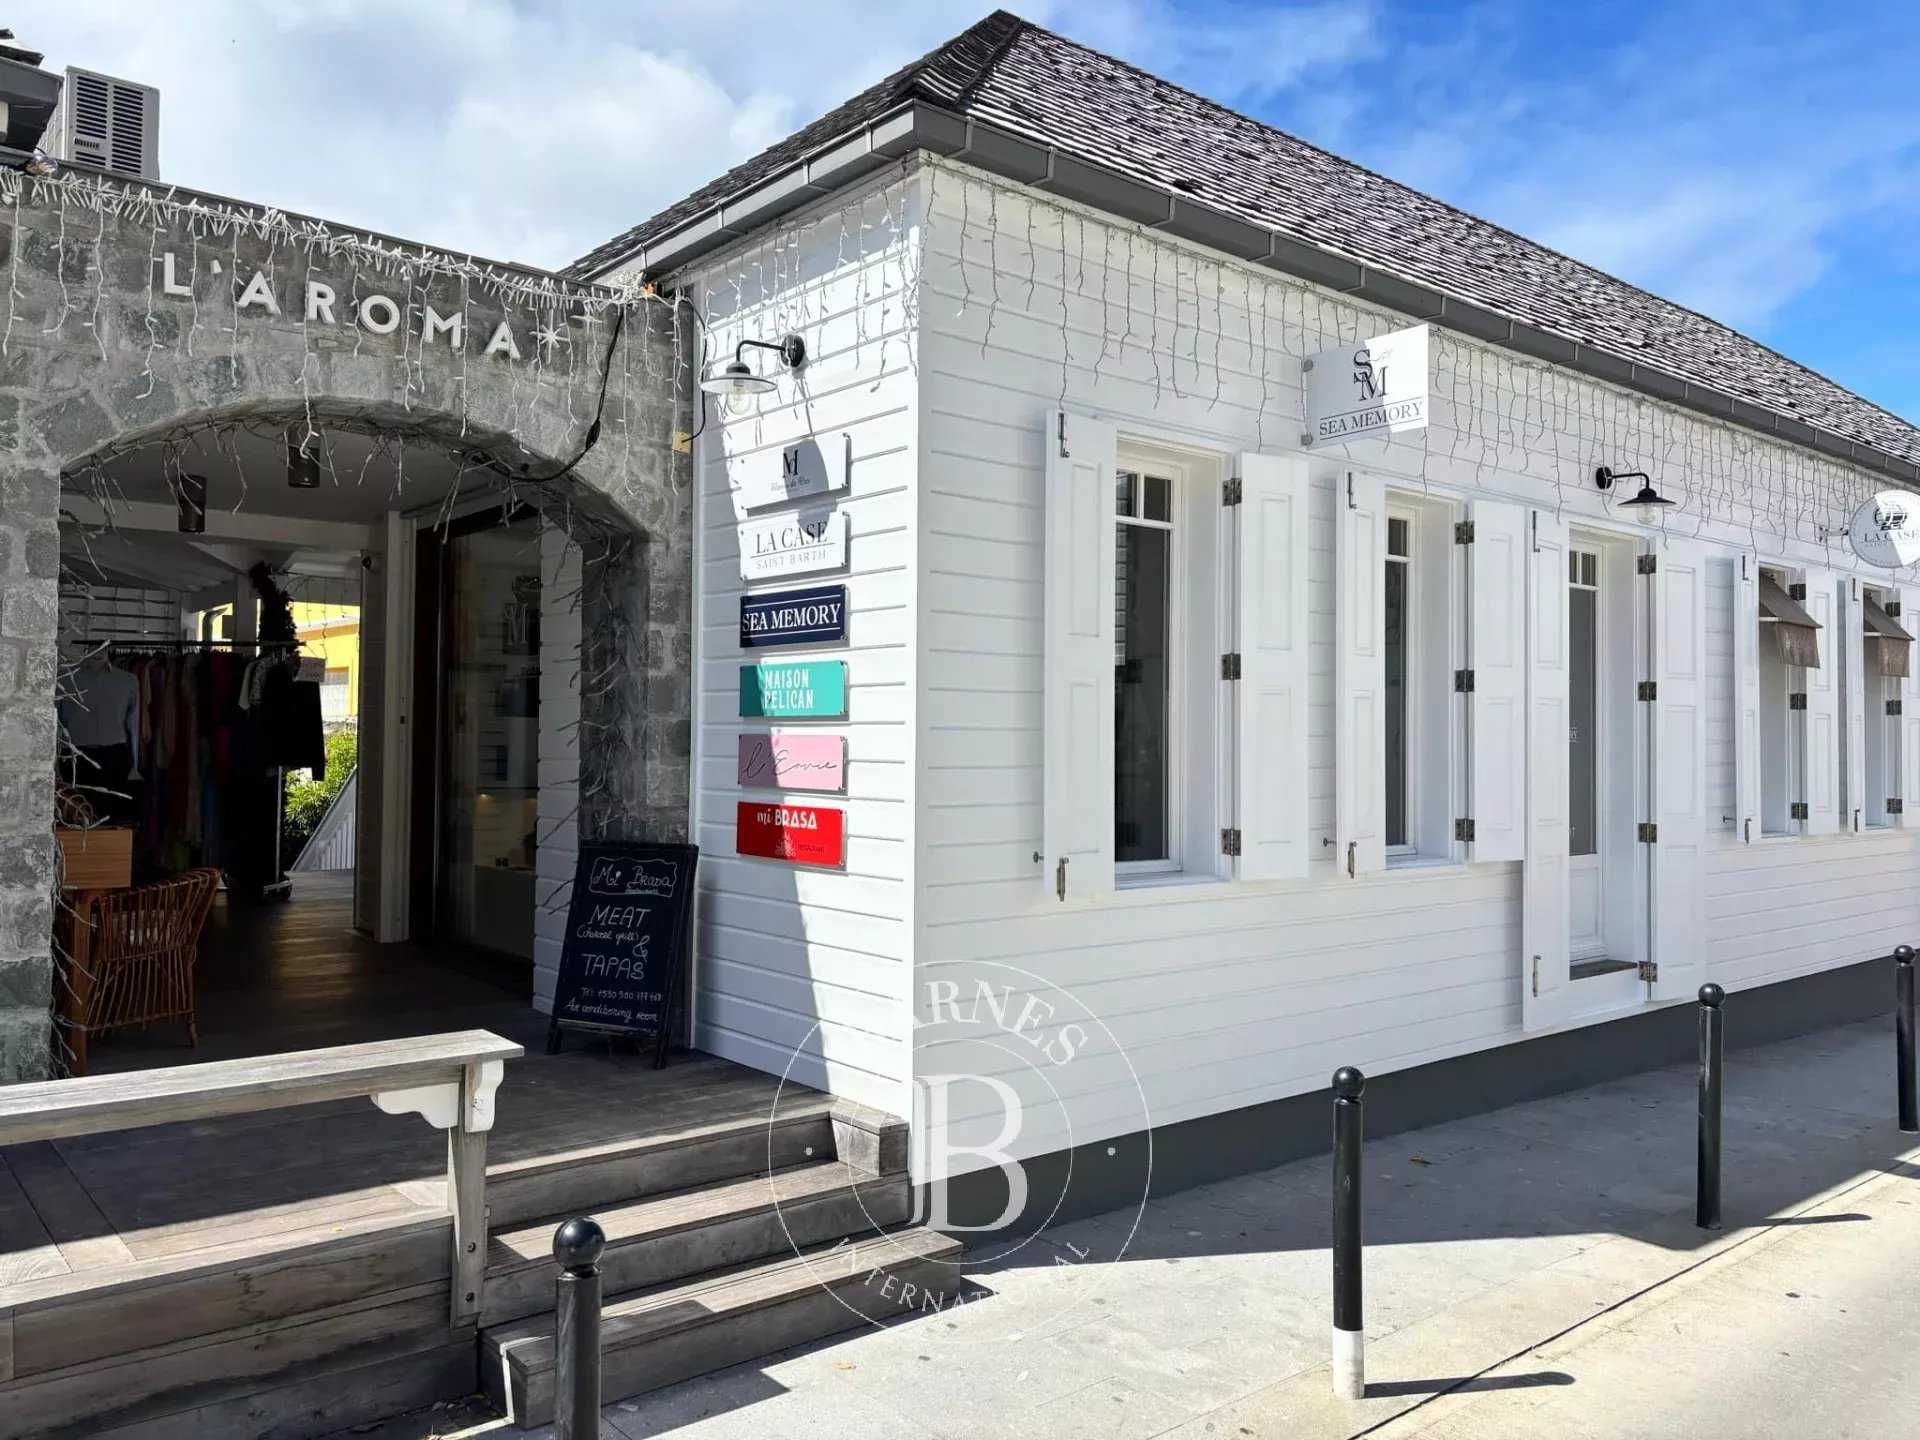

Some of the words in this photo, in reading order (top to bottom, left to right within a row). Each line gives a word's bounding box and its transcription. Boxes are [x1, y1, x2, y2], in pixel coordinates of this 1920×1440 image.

[163, 252, 521, 359] L'AROMA
[1319, 418, 1348, 435] SEA
[1351, 401, 1422, 429] MEMORY
[756, 532, 777, 554] LA
[781, 521, 829, 548] CASE
[742, 612, 769, 632] SEA
[770, 603, 841, 630] MEMORY
[764, 668, 809, 690] MAISON
[764, 689, 814, 709] PELICAN
[775, 809, 817, 829] BRASA
[587, 904, 653, 928] MEAT
[632, 935, 650, 963] &
[580, 953, 645, 980] TAPAS
